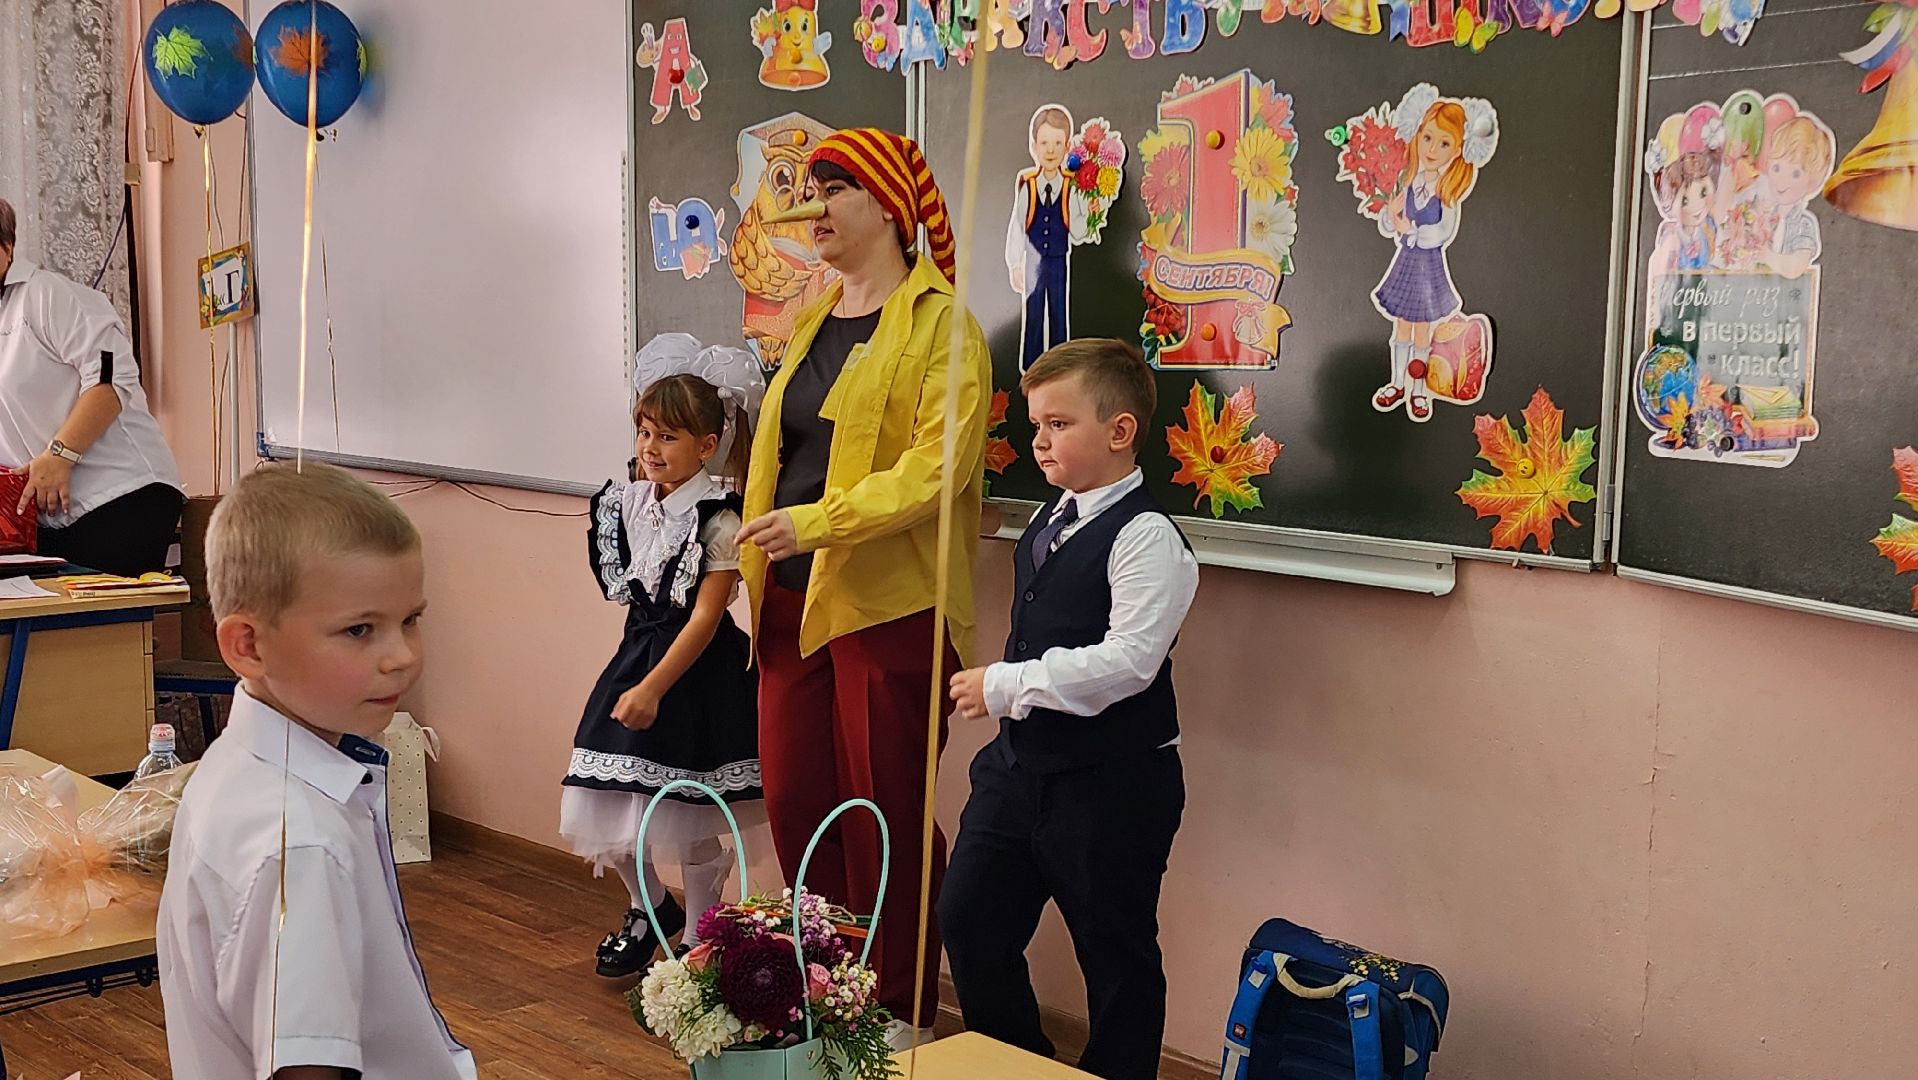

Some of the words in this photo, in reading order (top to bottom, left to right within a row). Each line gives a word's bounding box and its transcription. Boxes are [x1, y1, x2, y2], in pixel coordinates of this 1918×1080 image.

[1155, 255, 1276, 300] СЕНТЯБРЯ!
[1739, 285, 1781, 318] раз
[1682, 320, 1697, 342] в
[1703, 315, 1800, 350] первый
[1720, 349, 1800, 379] класс!
